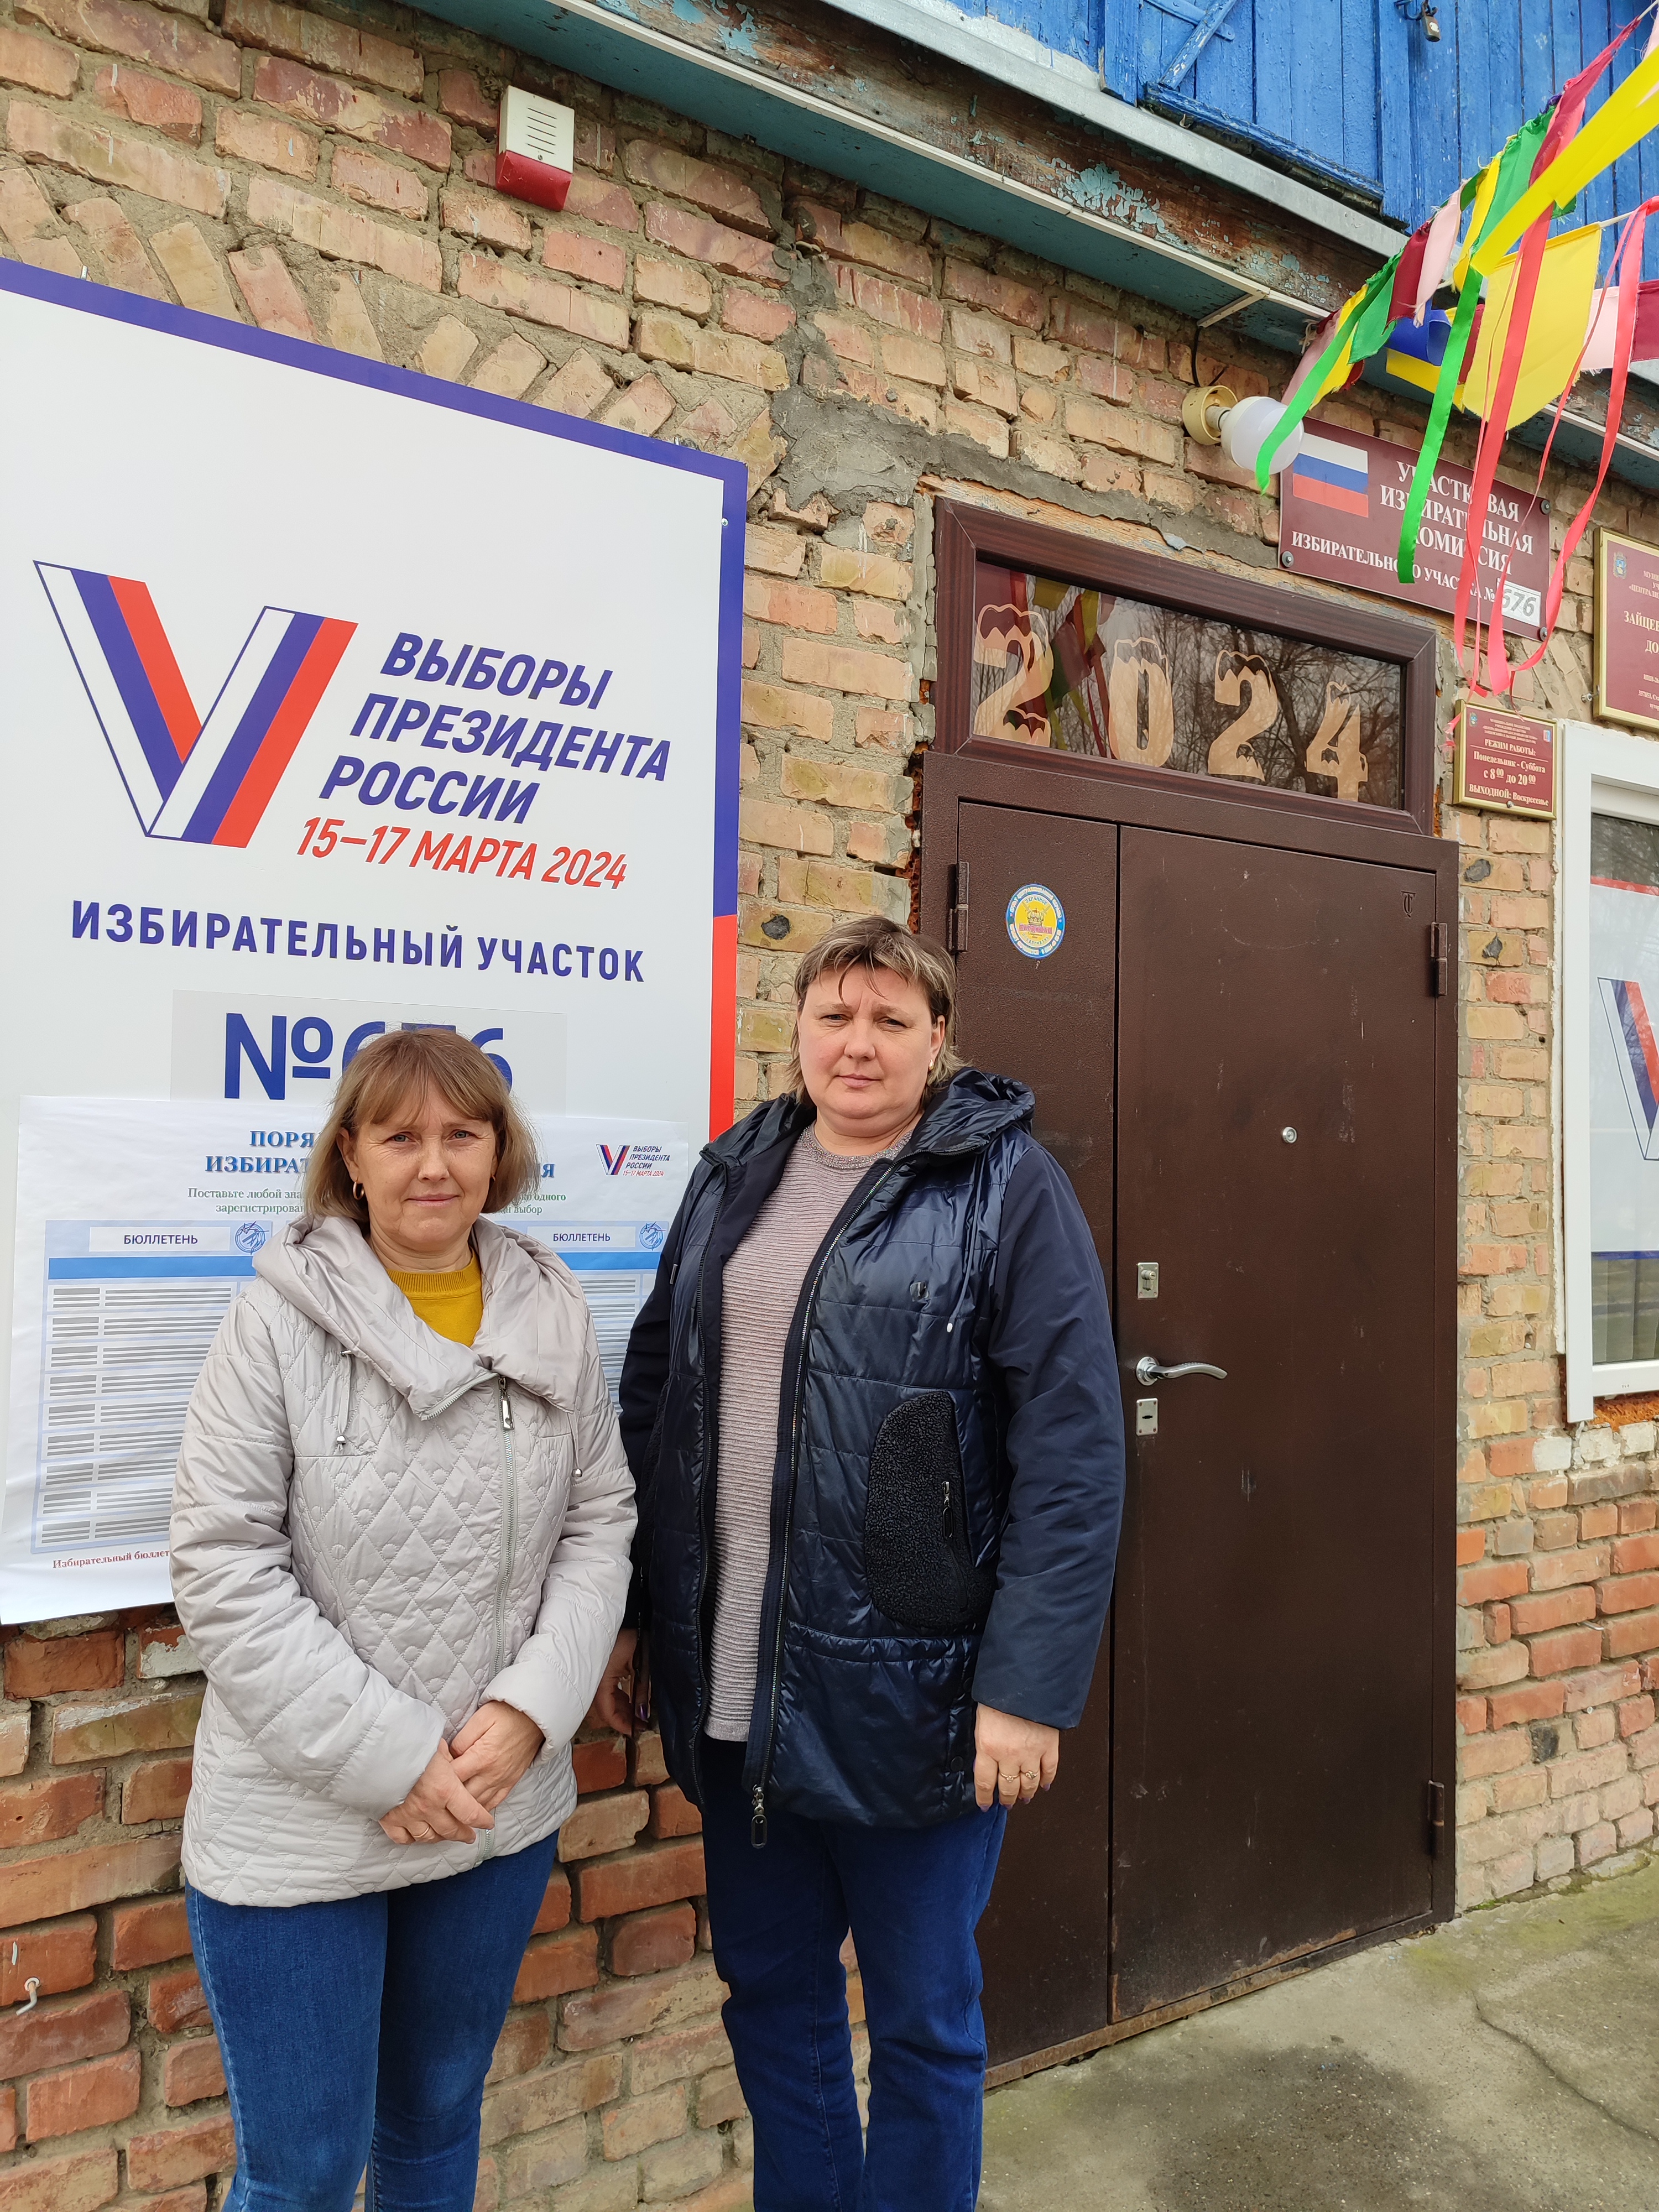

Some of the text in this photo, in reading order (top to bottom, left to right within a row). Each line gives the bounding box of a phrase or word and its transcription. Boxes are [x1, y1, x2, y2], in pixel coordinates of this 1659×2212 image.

[1396, 461, 1520, 523] УАСТКВАЯ
[1415, 526, 1511, 575] ОМИСИЯ
[1645, 639, 1659, 655] ДО
[380, 632, 613, 709] ВЫБОРЫ
[349, 693, 671, 781] ПРЕЗИДЕНТА
[1484, 738, 1536, 756] РЕЖИМ РАБОТЫ:
[1474, 750, 1516, 768] Понедельник
[1521, 760, 1546, 773] Суббота
[1506, 774, 1516, 784] до
[319, 755, 540, 824] РОССИИ
[1469, 783, 1549, 806] ВЫХОДНОЙ: Воскресенье
[409, 830, 538, 880] МАРТА
[541, 846, 628, 889] 2024
[72, 900, 645, 982] ИЗБИРАТЕЛЬНЫЙ УЧАСТОК
[249, 1130, 315, 1148] ПОРЯ
[205, 1155, 310, 1174] ИЗБИРАТ
[188, 1188, 244, 1199] Поставьте
[247, 1188, 281, 1199] любой
[216, 1204, 304, 1214] зарегистрирова
[514, 1204, 542, 1215] выбор
[123, 1235, 198, 1245] БЮЛЛЕТЕНЬ
[553, 1233, 611, 1242] БЮЛЛЕТЕНЬ
[53, 1550, 170, 1569] Избирательный бюллет
